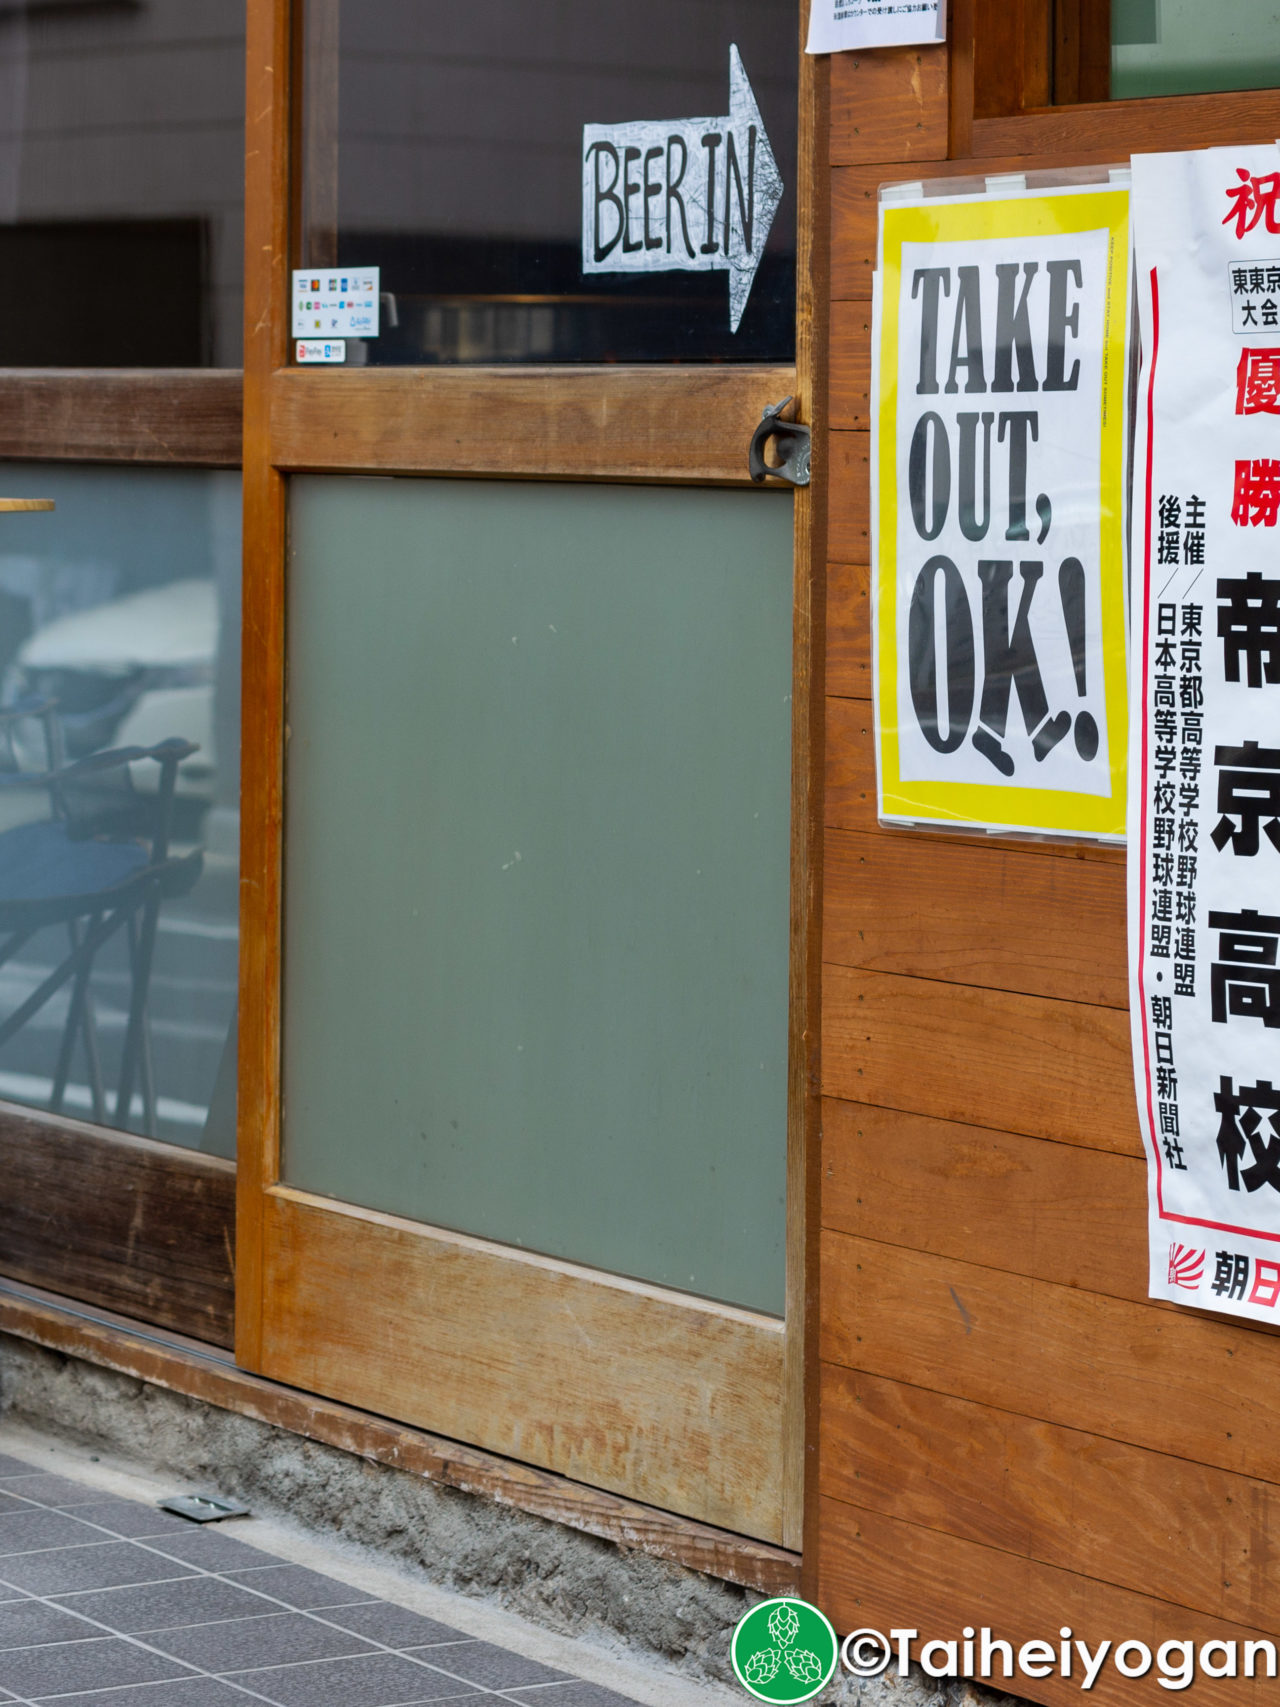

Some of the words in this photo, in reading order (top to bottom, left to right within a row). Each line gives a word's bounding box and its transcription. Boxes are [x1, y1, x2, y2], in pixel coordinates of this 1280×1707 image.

[585, 134, 696, 263] BEER
[700, 124, 757, 256] IN
[1222, 168, 1280, 240] 祝
[911, 258, 1084, 396] TAKE
[1232, 266, 1280, 295] 東東京
[1241, 298, 1279, 327] 大会
[908, 410, 1053, 545] OUT,
[908, 554, 1100, 778] OK!
[1210, 1250, 1280, 1308] 朝日
